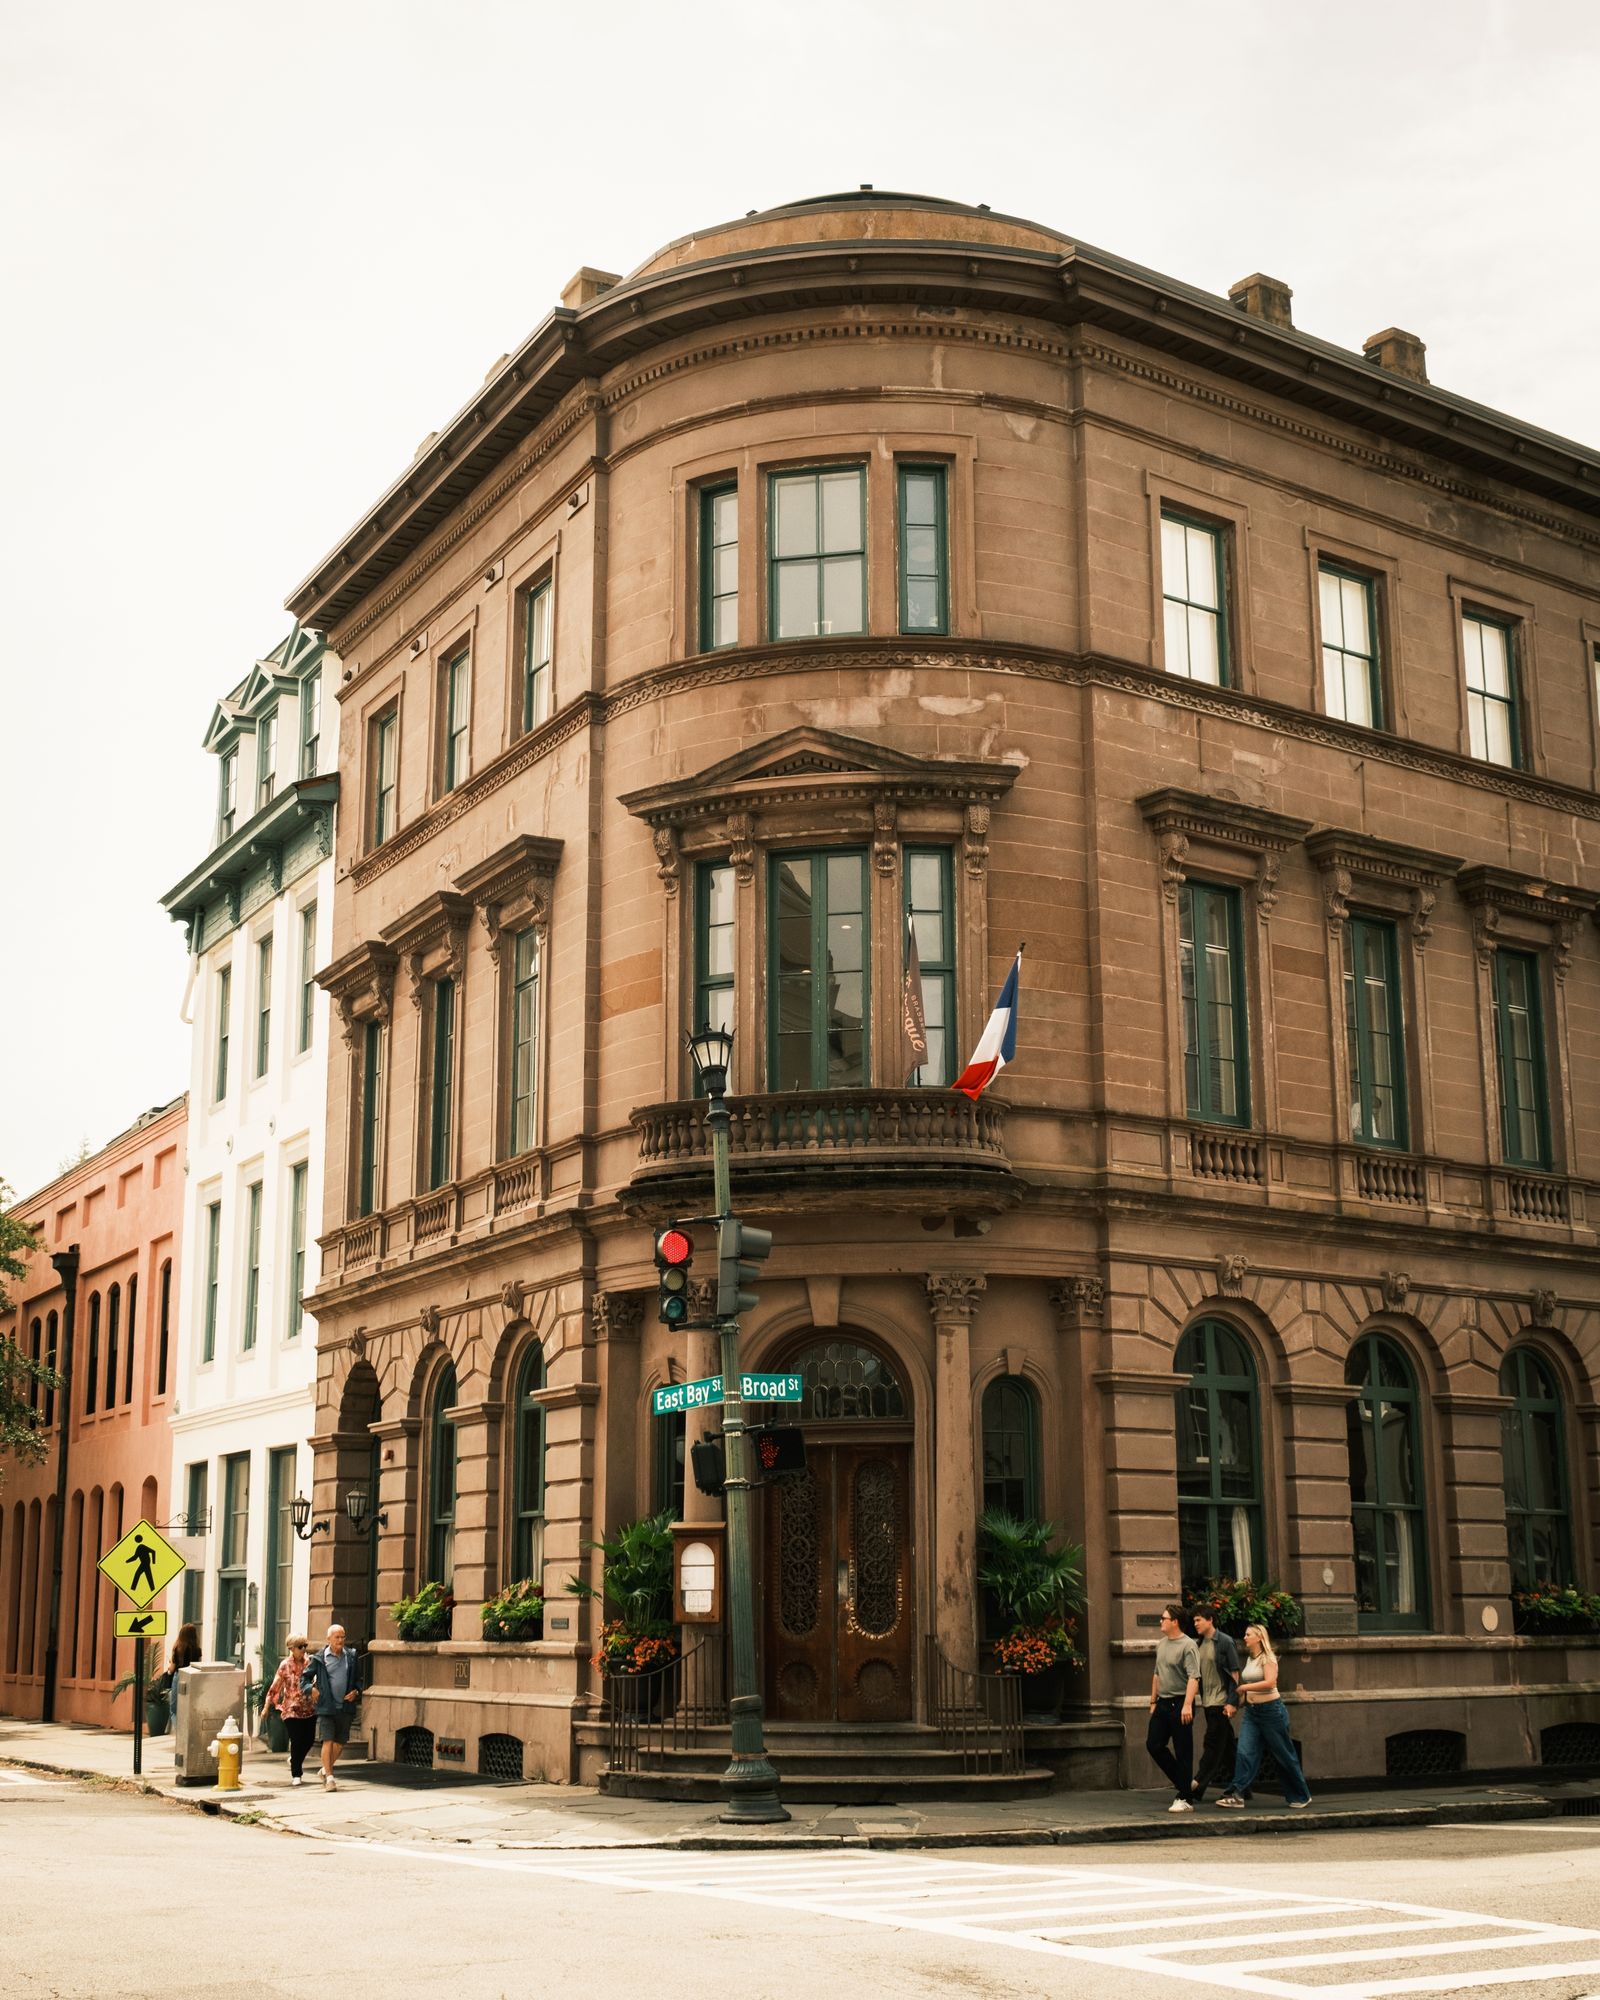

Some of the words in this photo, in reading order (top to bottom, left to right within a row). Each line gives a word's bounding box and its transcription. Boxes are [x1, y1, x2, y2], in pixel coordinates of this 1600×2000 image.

[656, 1388, 684, 1411] East
[687, 1385, 710, 1404] Bay
[712, 1379, 721, 1392] St
[743, 1377, 786, 1396] Broad
[788, 1378, 799, 1390] St
